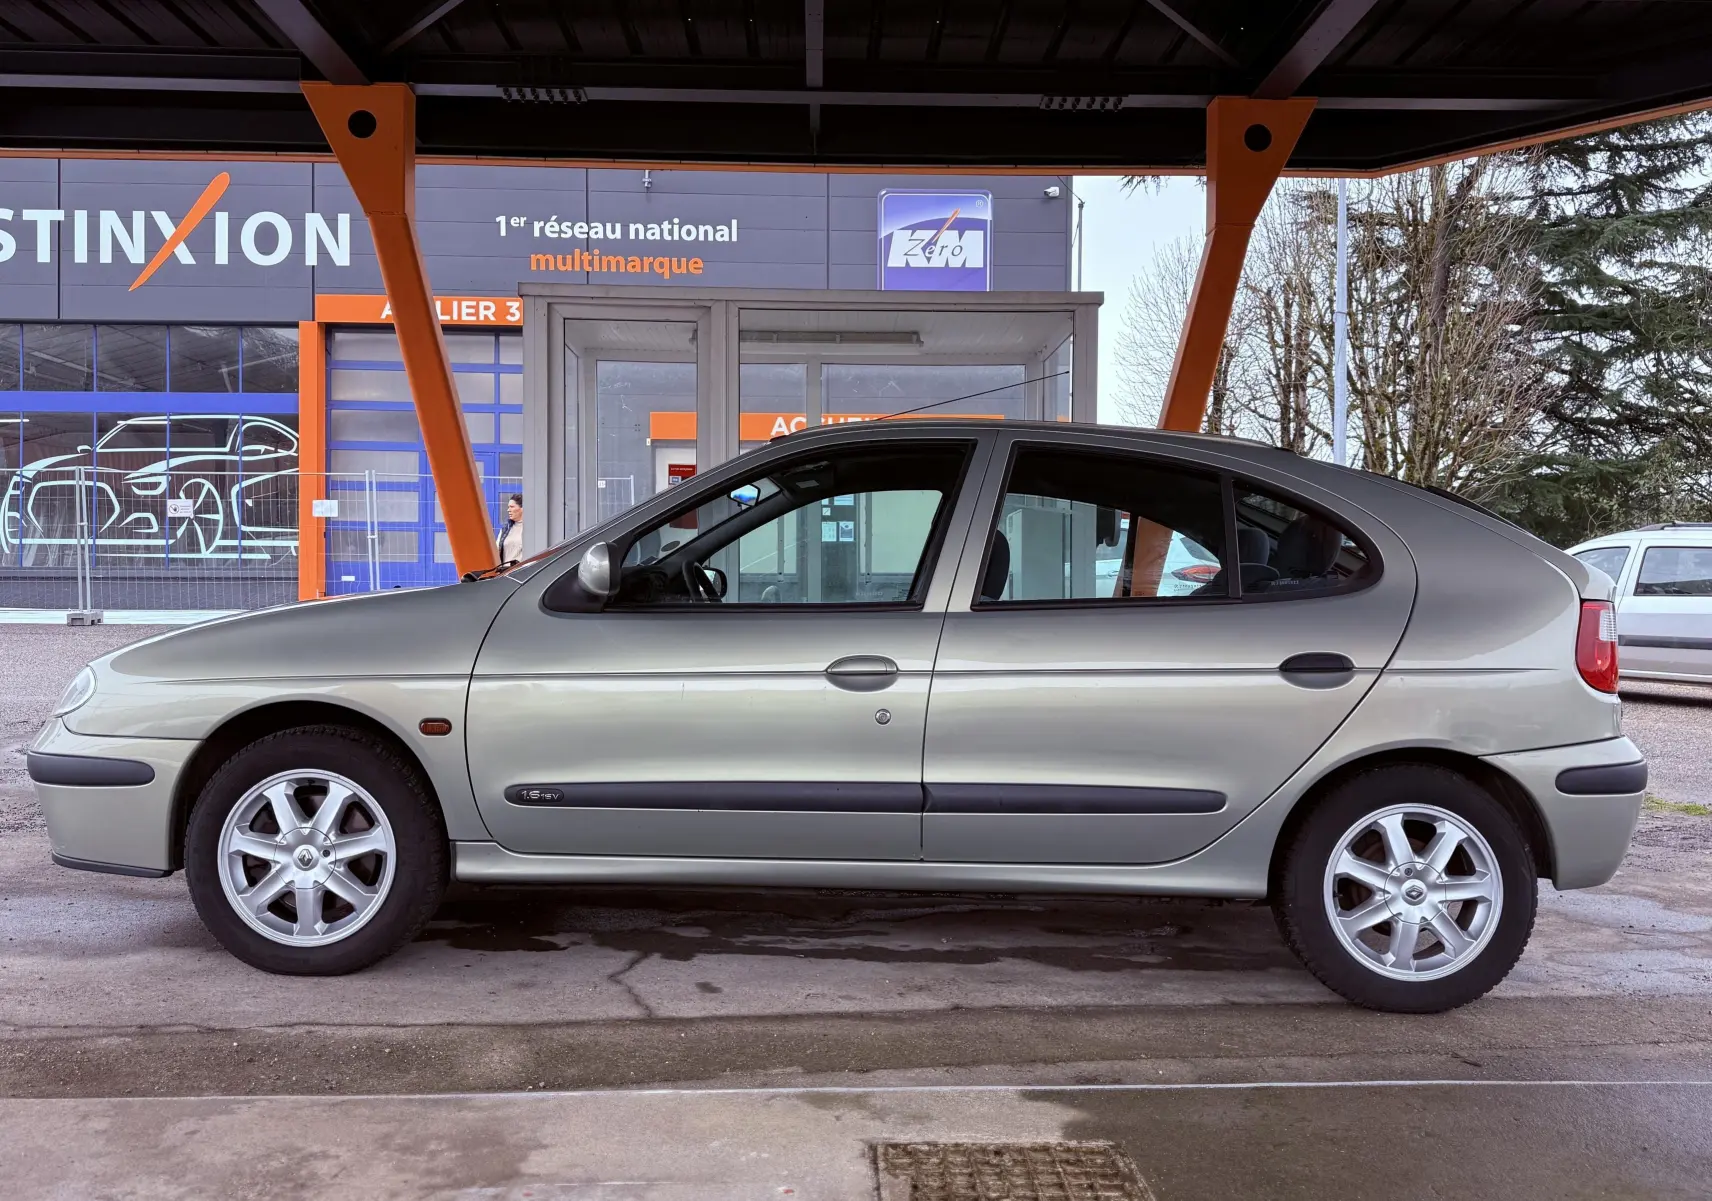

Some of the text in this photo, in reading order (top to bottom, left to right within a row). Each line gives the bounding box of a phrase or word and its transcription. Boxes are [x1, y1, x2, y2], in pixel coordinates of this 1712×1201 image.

[533, 215, 621, 239] réseau
[629, 218, 738, 242] national
[887, 229, 984, 268] KM
[530, 248, 704, 279] multimarque
[381, 301, 521, 321] ALIER 3
